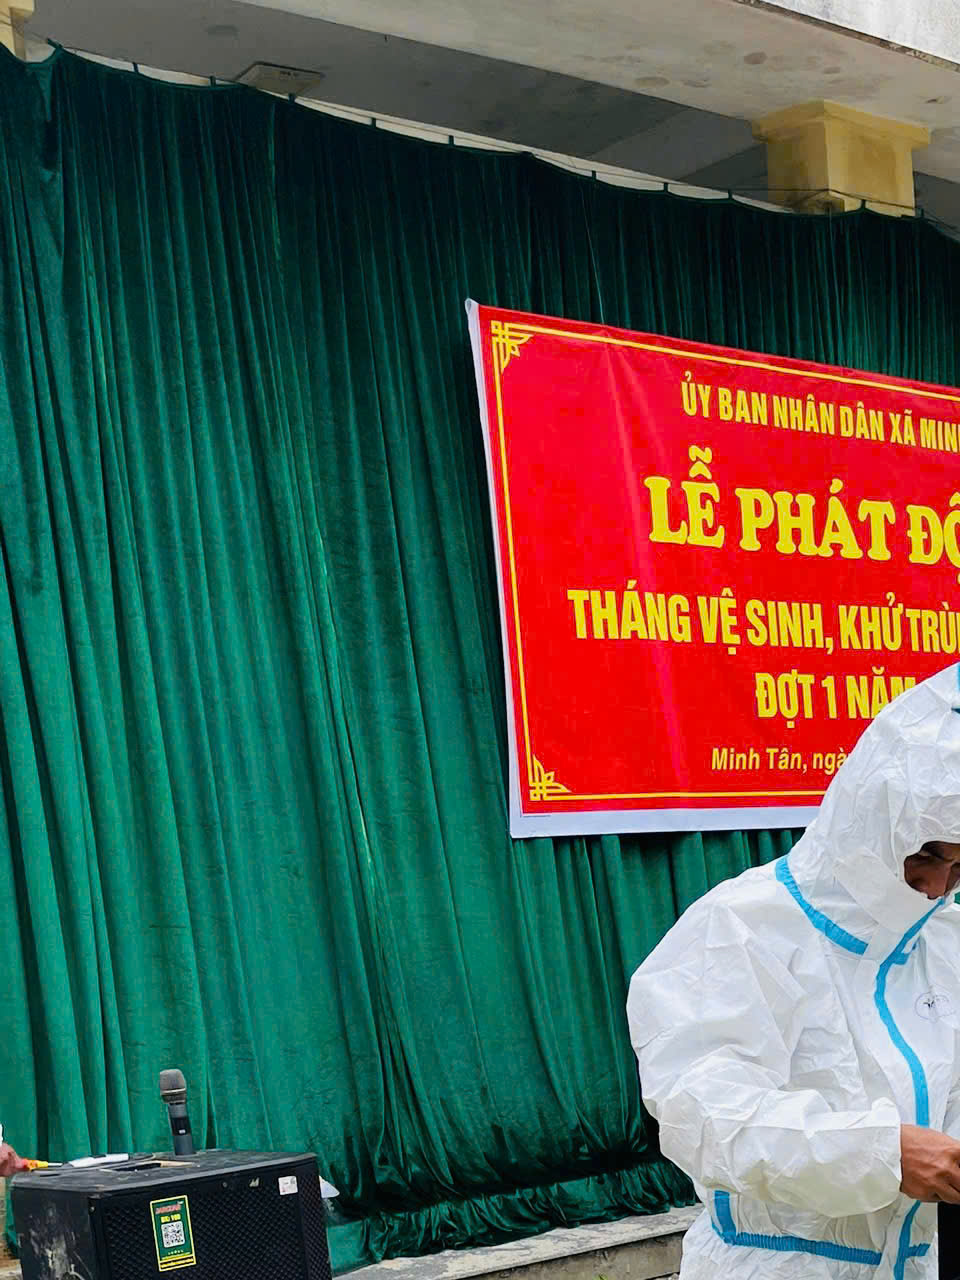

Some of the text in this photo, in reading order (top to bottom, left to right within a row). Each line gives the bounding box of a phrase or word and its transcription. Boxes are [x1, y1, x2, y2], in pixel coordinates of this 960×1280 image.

[682, 371, 711, 417] ỦY
[718, 387, 767, 425] BAN
[773, 394, 834, 435] NHÂN
[840, 401, 884, 441] DÂN
[889, 409, 916, 446] XÃ
[644, 445, 724, 548] LỄ
[735, 479, 896, 560] PHÁT
[567, 580, 691, 642] THÁNG
[697, 588, 740, 655] VỆ
[746, 600, 833, 655] SINH,
[839, 592, 904, 650] KHỬ
[755, 669, 814, 728] ĐỢT
[822, 676, 837, 718] 1
[712, 747, 848, 775] Minh Tân, ngà
